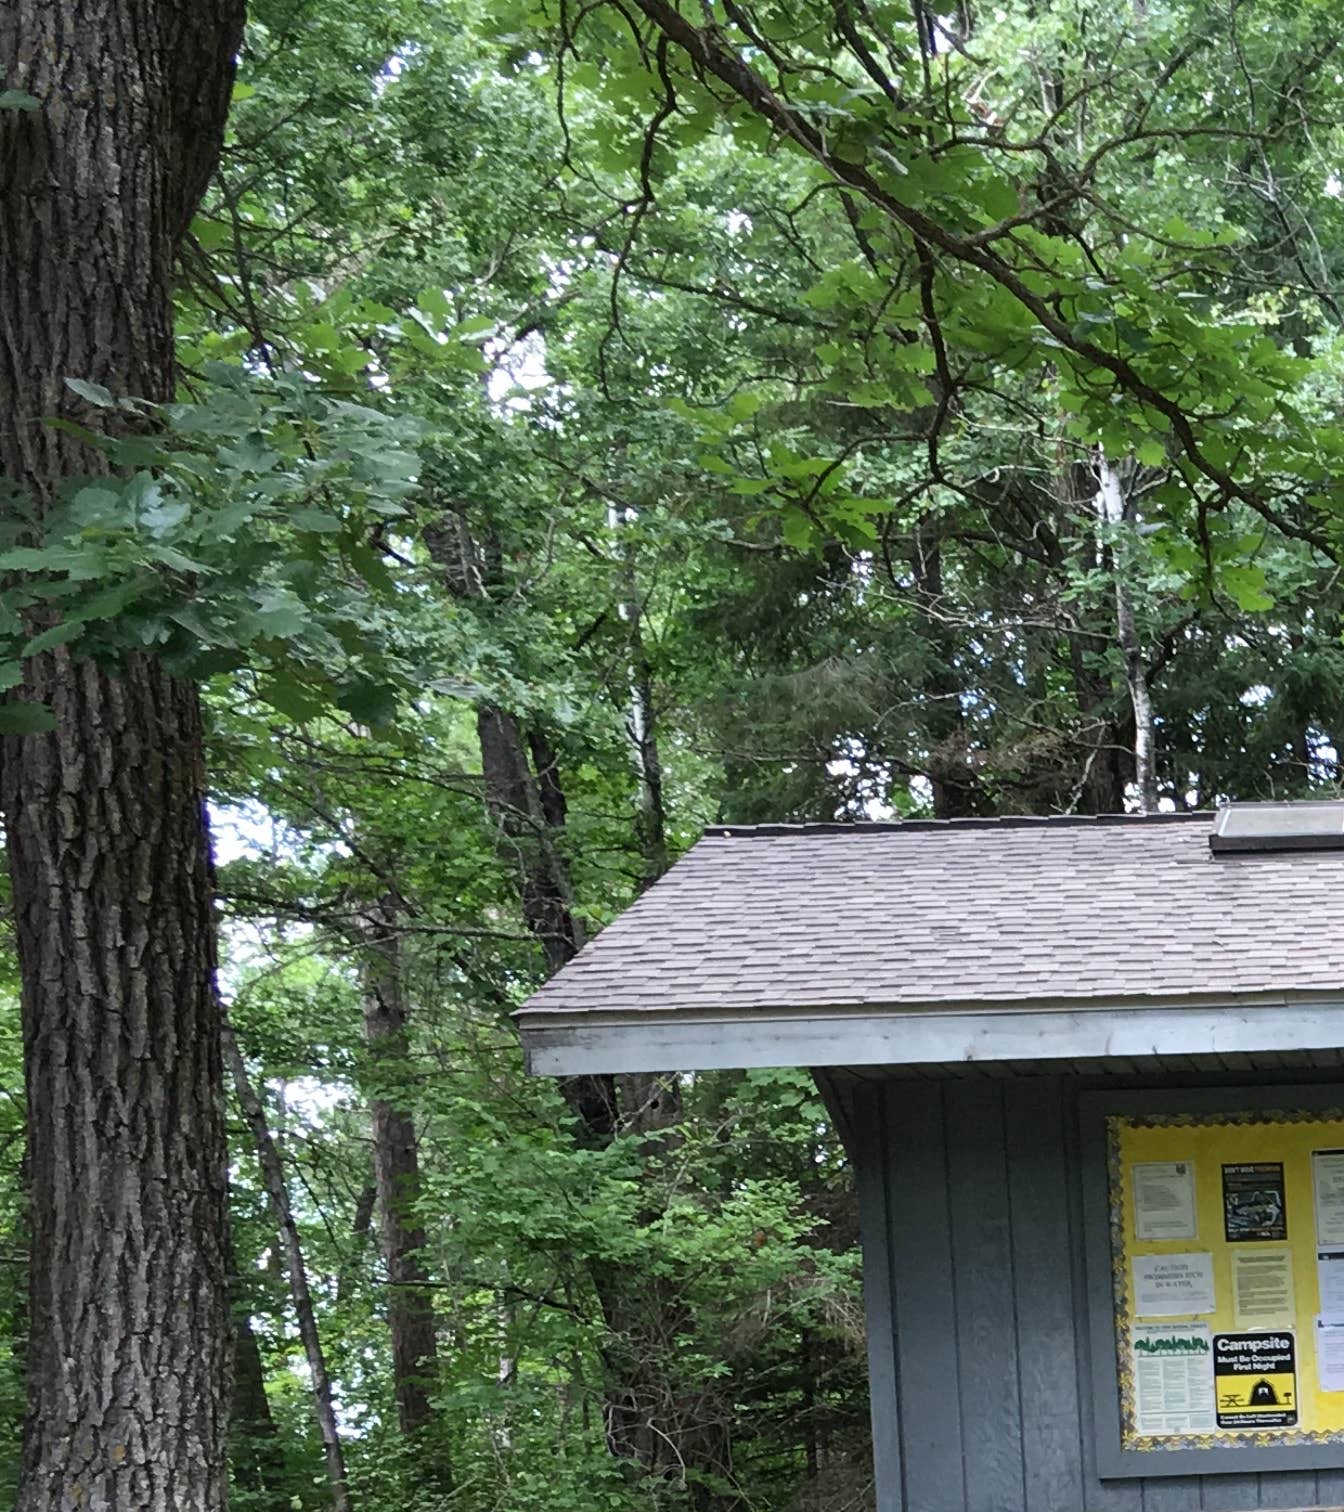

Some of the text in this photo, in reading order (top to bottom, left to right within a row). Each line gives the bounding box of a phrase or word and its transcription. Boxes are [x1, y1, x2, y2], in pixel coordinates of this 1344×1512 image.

[1217, 1336, 1290, 1352] Campsite
[1251, 1353, 1291, 1361] Occupied
[1252, 1363, 1276, 1371] Night
